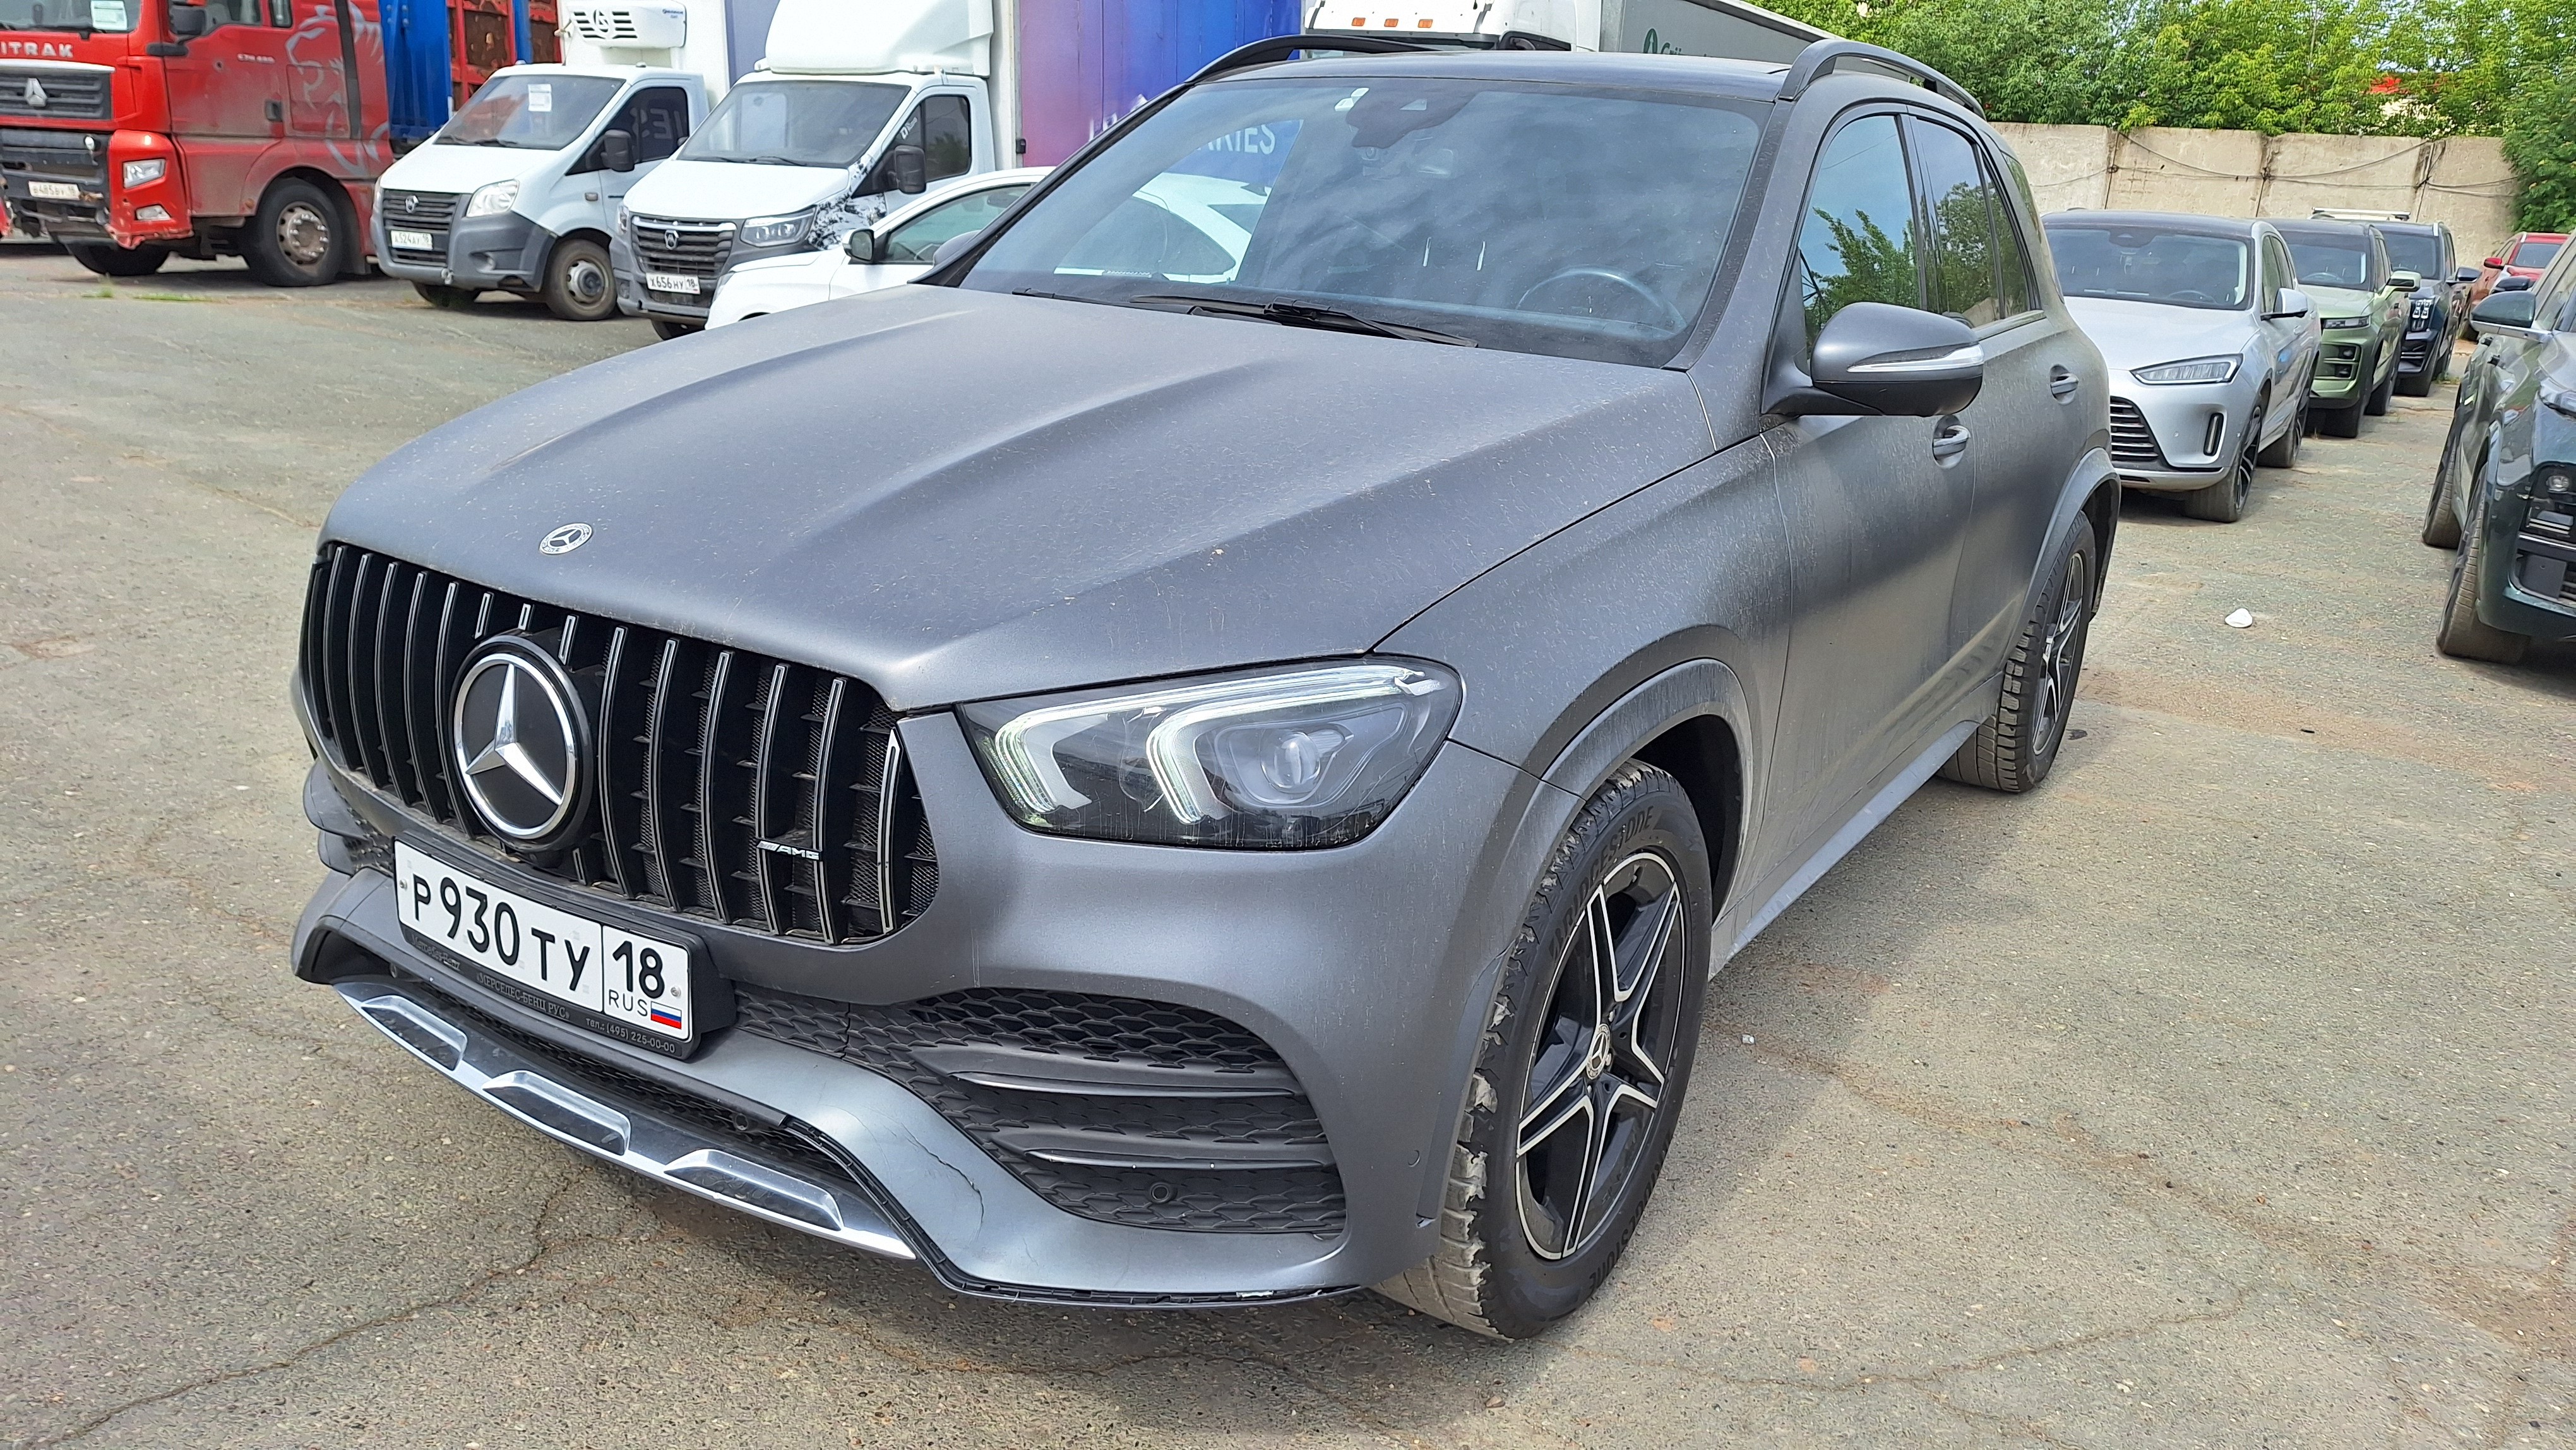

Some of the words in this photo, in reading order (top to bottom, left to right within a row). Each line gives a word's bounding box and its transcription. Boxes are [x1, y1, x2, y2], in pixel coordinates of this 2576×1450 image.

[775, 845, 820, 860] AMG
[612, 940, 665, 999] 18
[609, 989, 648, 1017] RUS
[607, 1022, 629, 1040] (495)
[631, 1031, 676, 1054] 225-00-00
